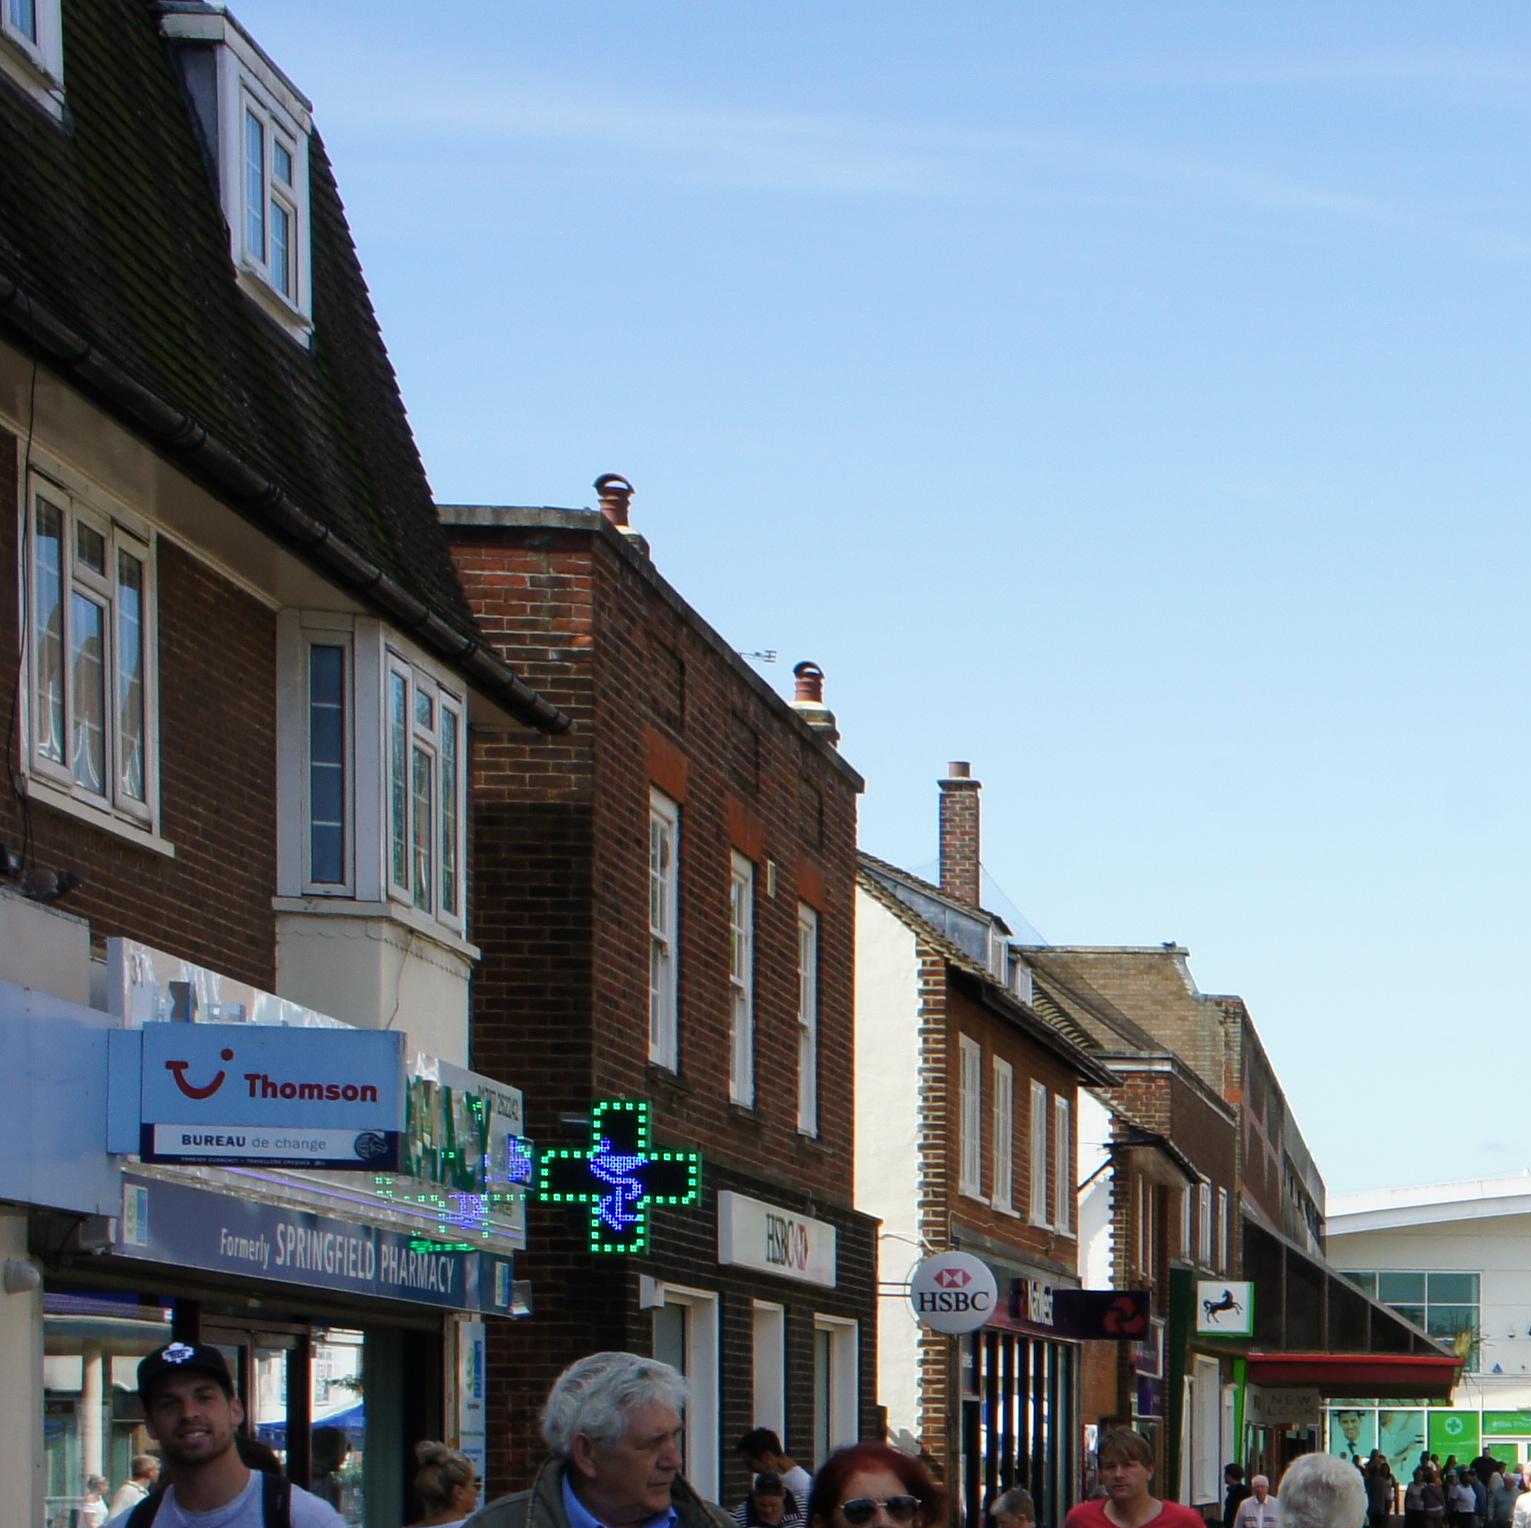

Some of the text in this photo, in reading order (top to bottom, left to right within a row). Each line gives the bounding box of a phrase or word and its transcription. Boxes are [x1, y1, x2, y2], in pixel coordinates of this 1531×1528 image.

[243, 1073, 378, 1102] Thomson
[181, 1133, 327, 1152] BUREAU de change
[766, 1213, 795, 1269] HSBC
[220, 1227, 271, 1270] Formerly
[275, 1222, 376, 1281] SPRINGFIELD
[379, 1243, 456, 1294] PHARMACY
[918, 1291, 990, 1312] HSBC
